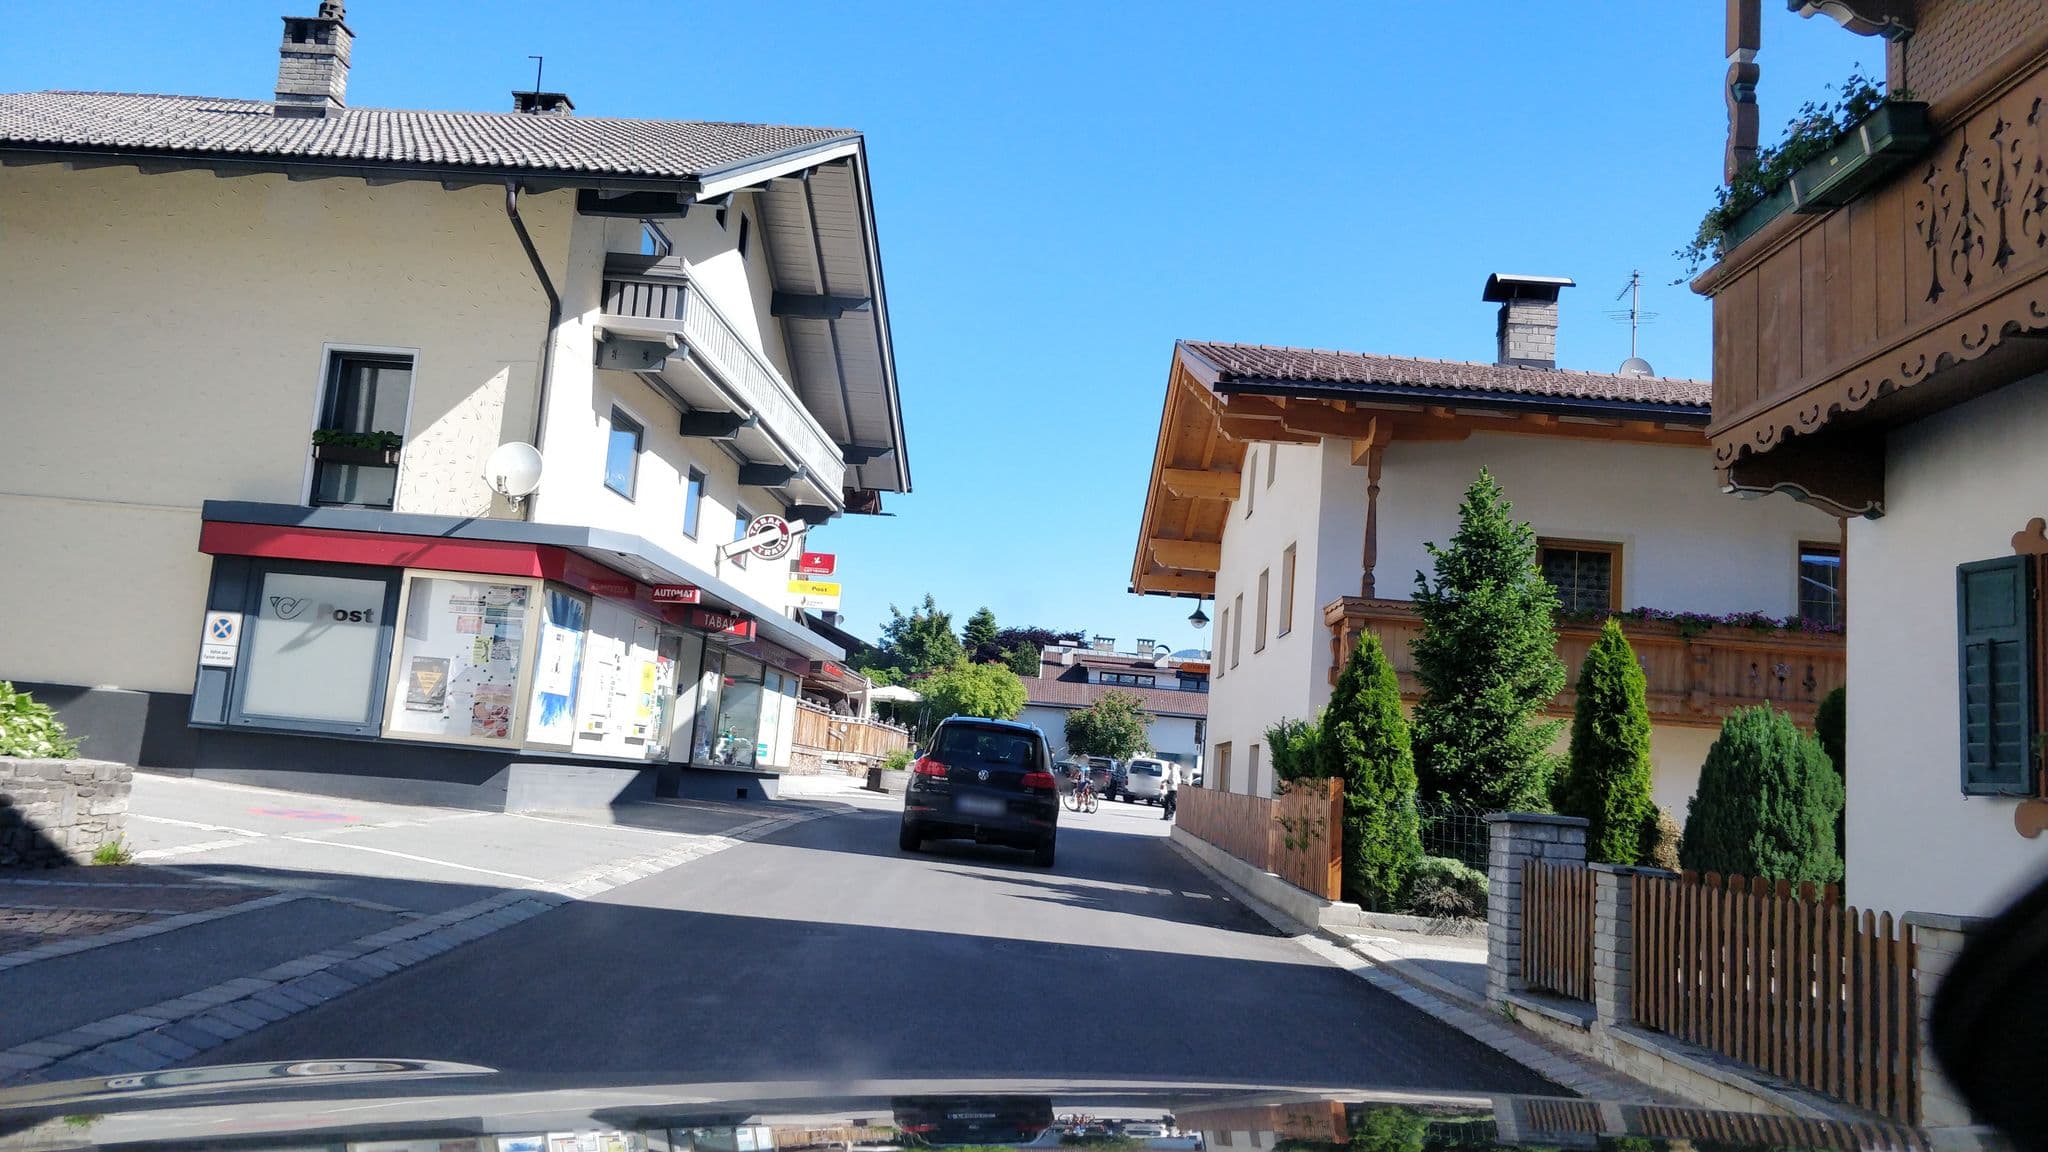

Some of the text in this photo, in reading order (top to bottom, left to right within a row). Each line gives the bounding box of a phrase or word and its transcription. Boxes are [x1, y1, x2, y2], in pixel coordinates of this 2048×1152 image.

[749, 516, 781, 534] TABAK
[757, 534, 788, 556] TRAFIK
[653, 589, 694, 598] AUTOMAT
[704, 614, 736, 631] TABAK
